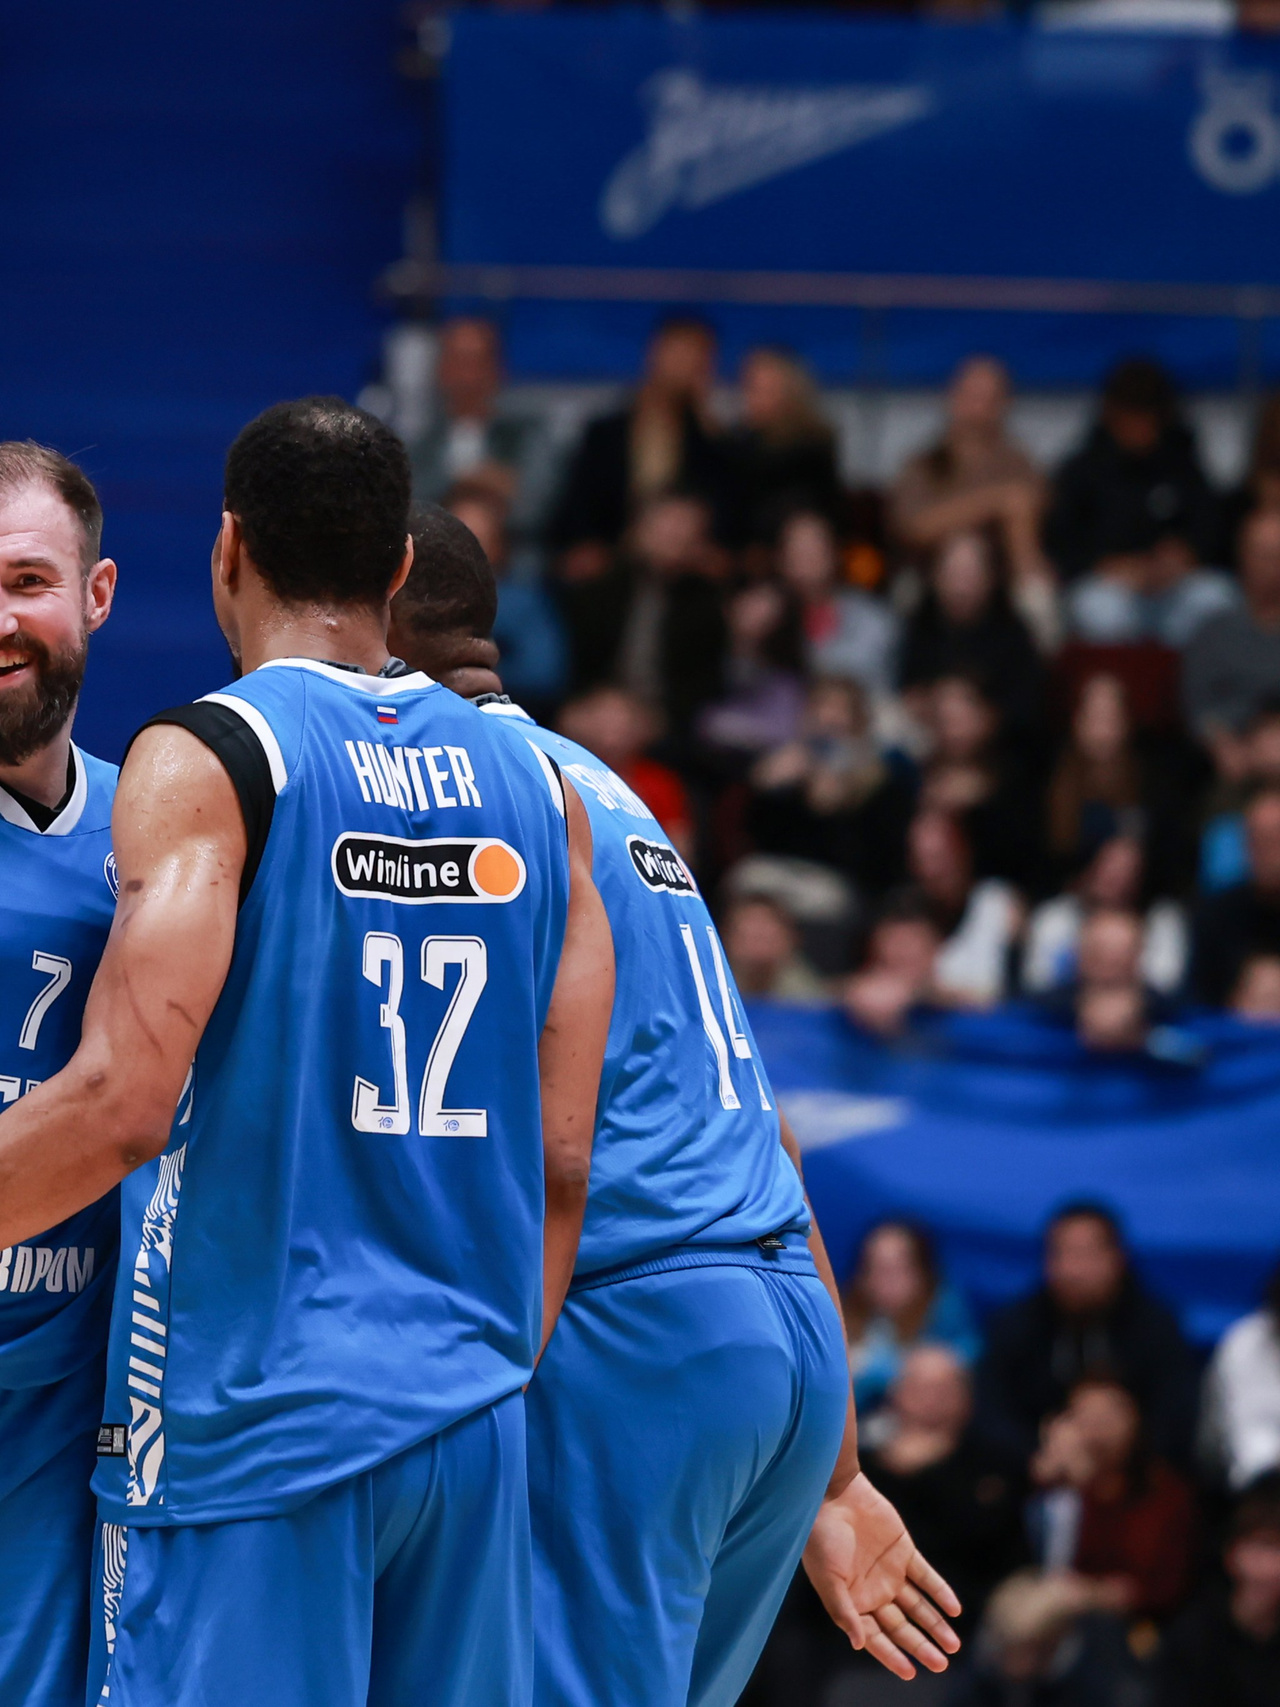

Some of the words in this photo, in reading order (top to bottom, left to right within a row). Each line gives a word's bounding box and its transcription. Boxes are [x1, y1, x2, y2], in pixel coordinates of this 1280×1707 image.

[345, 740, 482, 811] HUNTER
[346, 846, 460, 888] Winline
[18, 950, 73, 1051] 7
[351, 930, 488, 1138] 32
